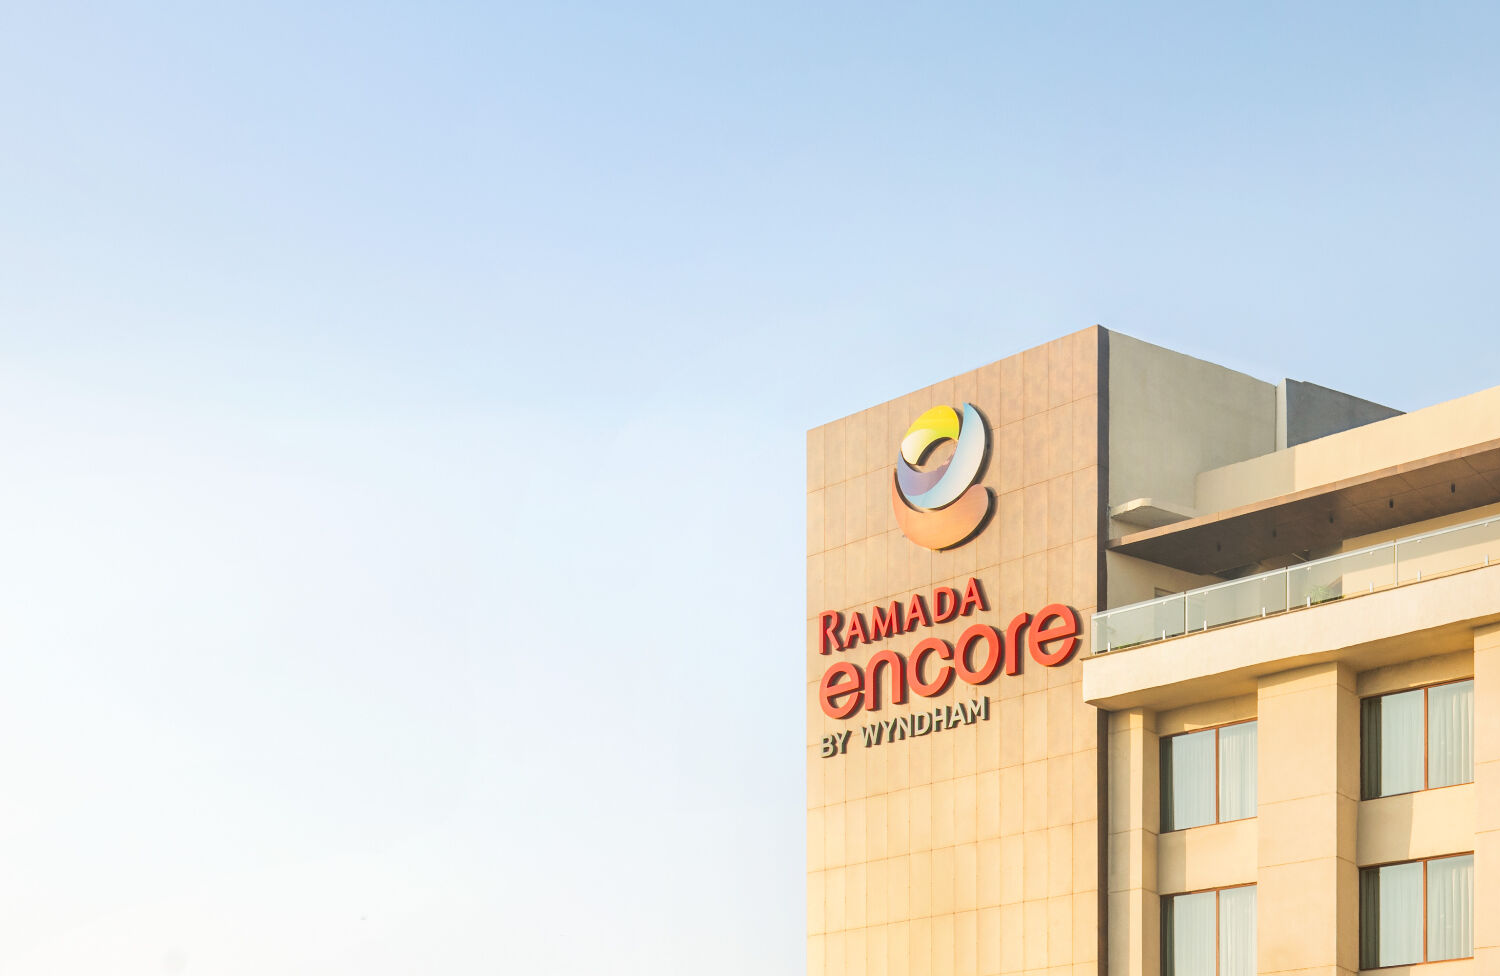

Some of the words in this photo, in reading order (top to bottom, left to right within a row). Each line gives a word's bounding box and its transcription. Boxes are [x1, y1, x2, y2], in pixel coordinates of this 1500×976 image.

[818, 577, 987, 655] RAMADA
[819, 603, 1079, 719] encore
[820, 729, 852, 758] BY
[860, 696, 989, 748] WYNDHAM
